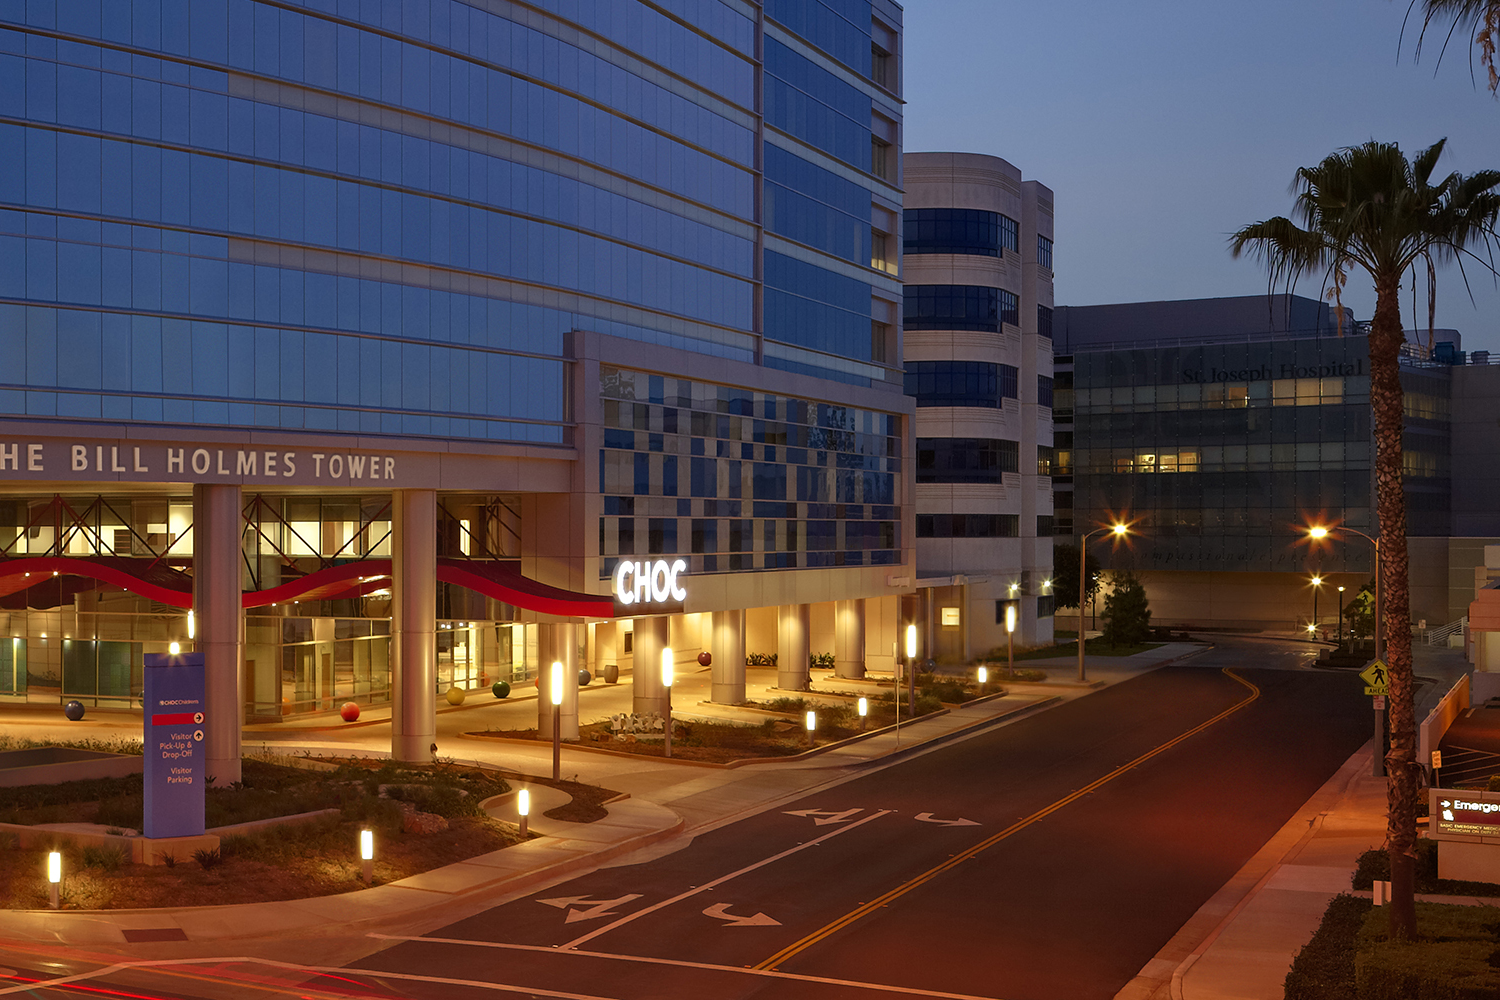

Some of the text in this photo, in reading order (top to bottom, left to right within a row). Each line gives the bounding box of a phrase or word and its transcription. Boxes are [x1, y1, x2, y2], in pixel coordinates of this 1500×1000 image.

[1182, 359, 1363, 384] St. Joseph Hospital
[71, 444, 149, 472] BILL
[167, 448, 296, 477] HOLMES
[312, 453, 395, 480] TOWER
[1131, 548, 1271, 564] ompassionate
[617, 559, 687, 605] CHOC
[159, 741, 185, 750] Pick-Up
[162, 750, 192, 759] Drop-Off
[167, 776, 192, 784] Parking
[1454, 799, 1500, 814] Emerge
